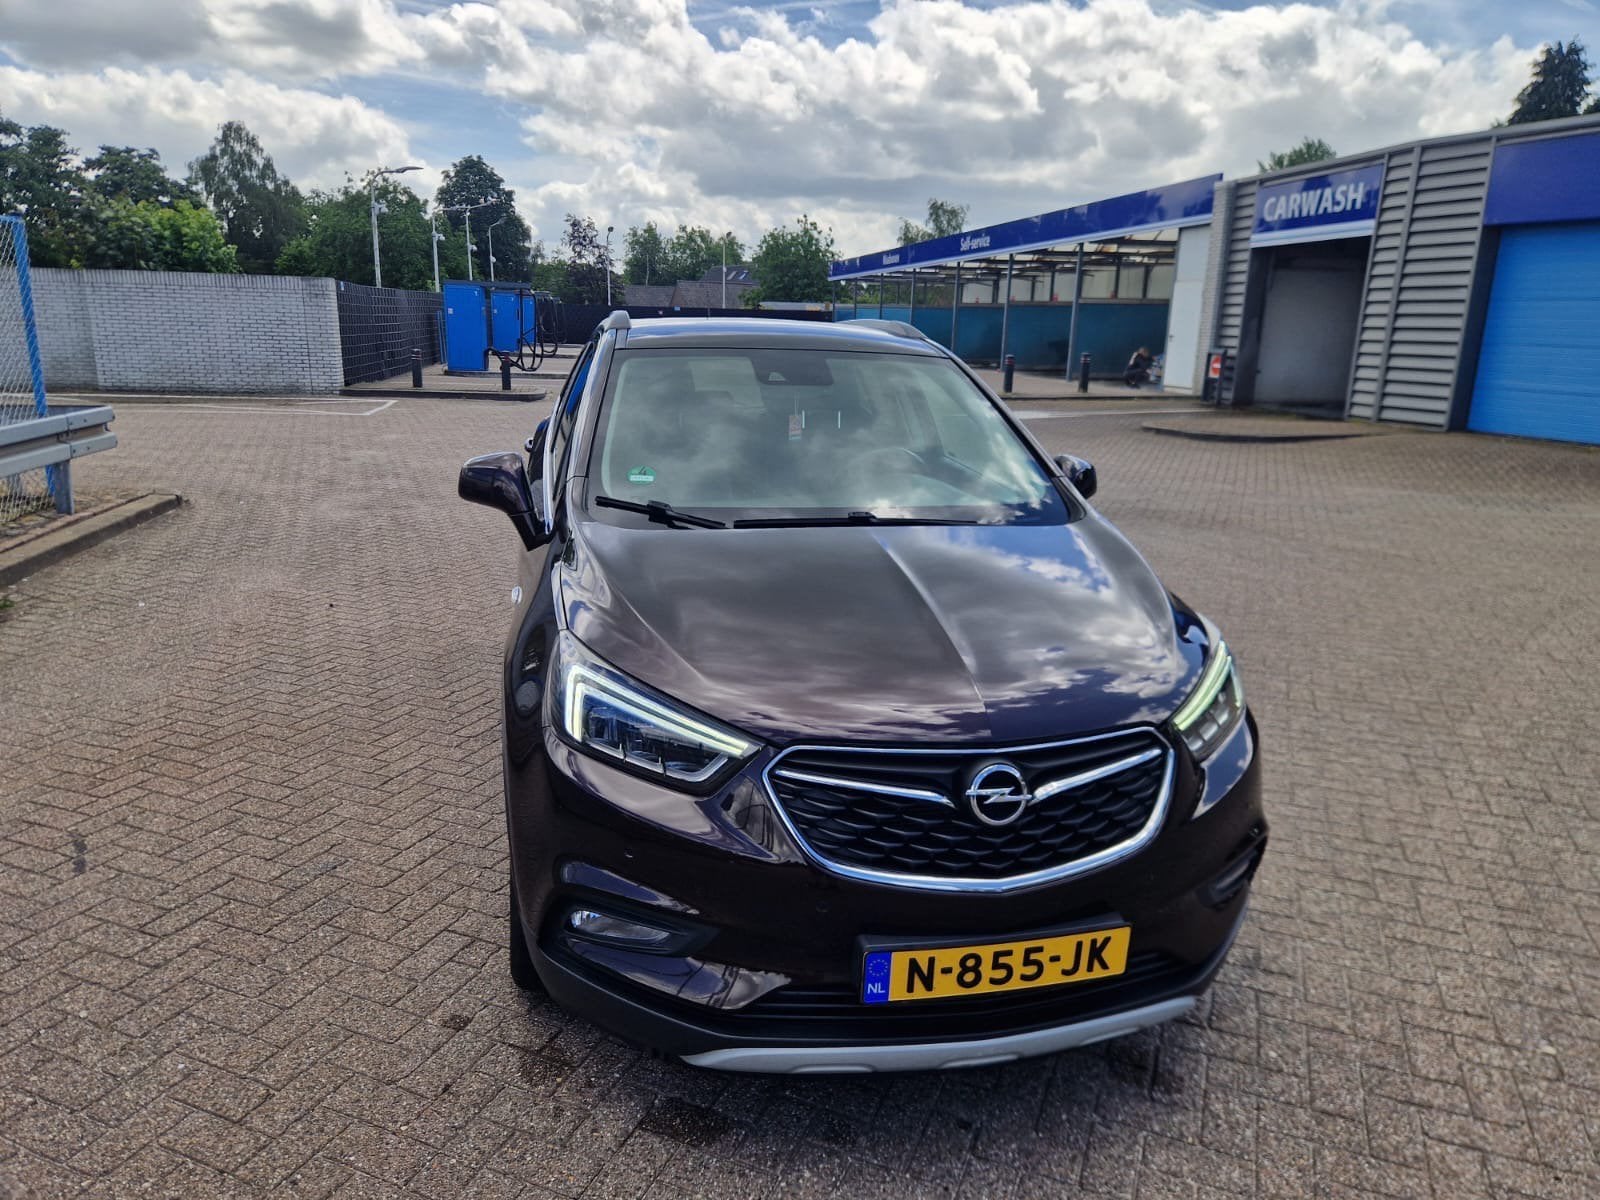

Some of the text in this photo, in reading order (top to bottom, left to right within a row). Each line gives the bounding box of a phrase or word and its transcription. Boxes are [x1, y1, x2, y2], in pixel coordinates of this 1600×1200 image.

[1263, 182, 1364, 222] CARWASH
[867, 936, 1112, 994] NL N-855-JK
